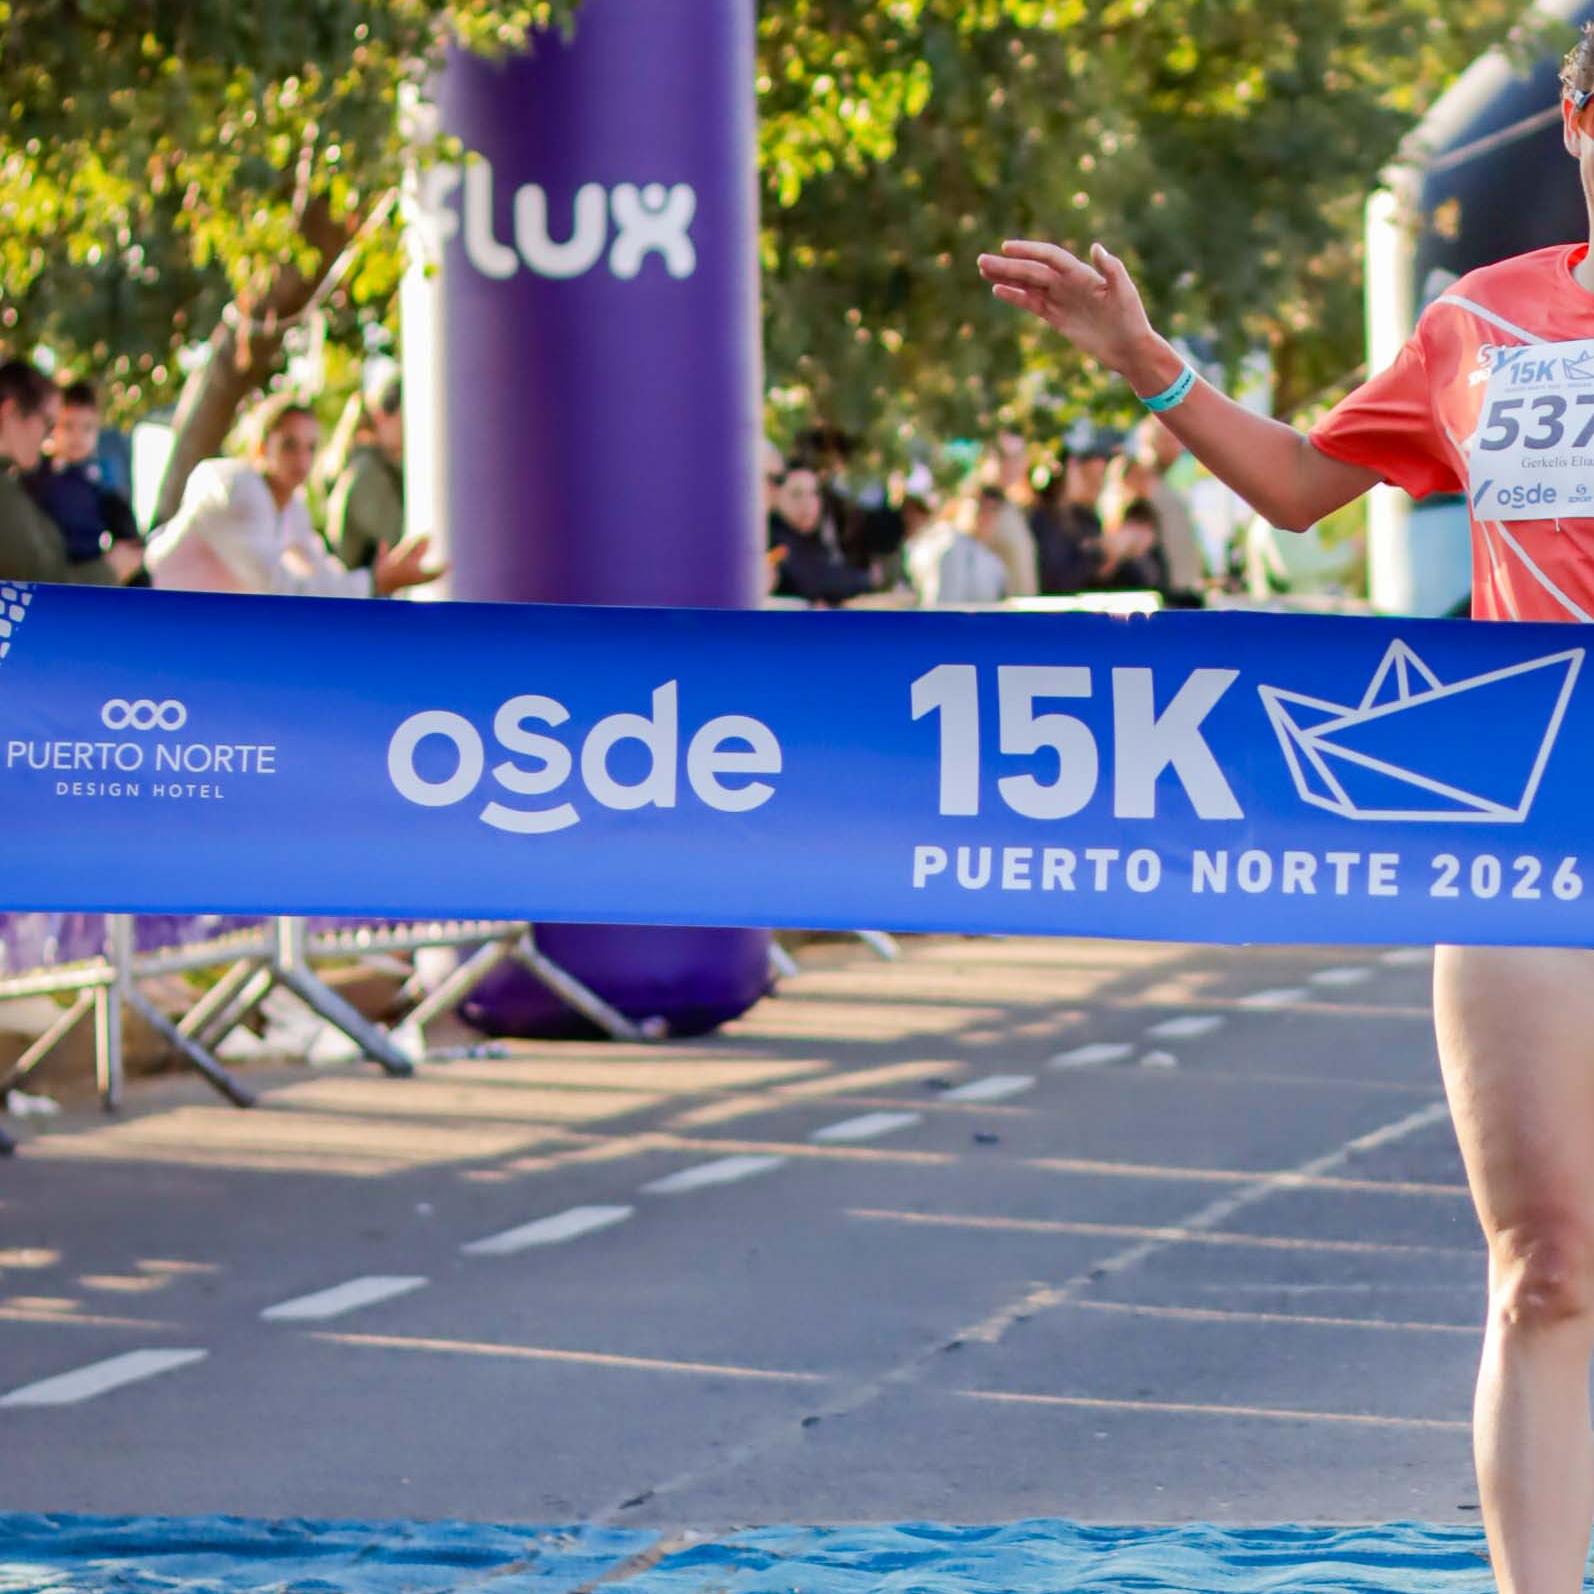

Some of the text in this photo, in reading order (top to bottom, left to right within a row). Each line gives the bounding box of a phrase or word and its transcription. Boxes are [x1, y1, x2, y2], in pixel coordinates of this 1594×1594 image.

[1510, 358, 1557, 385] 15K
[1497, 482, 1557, 506] osde
[7, 741, 276, 774] PUERTO NORTE
[387, 680, 783, 813] osde
[910, 664, 1246, 820] 15K
[56, 782, 224, 799] DESIGN HOTEL
[912, 845, 1584, 902] PUERTO NORTE 2026
